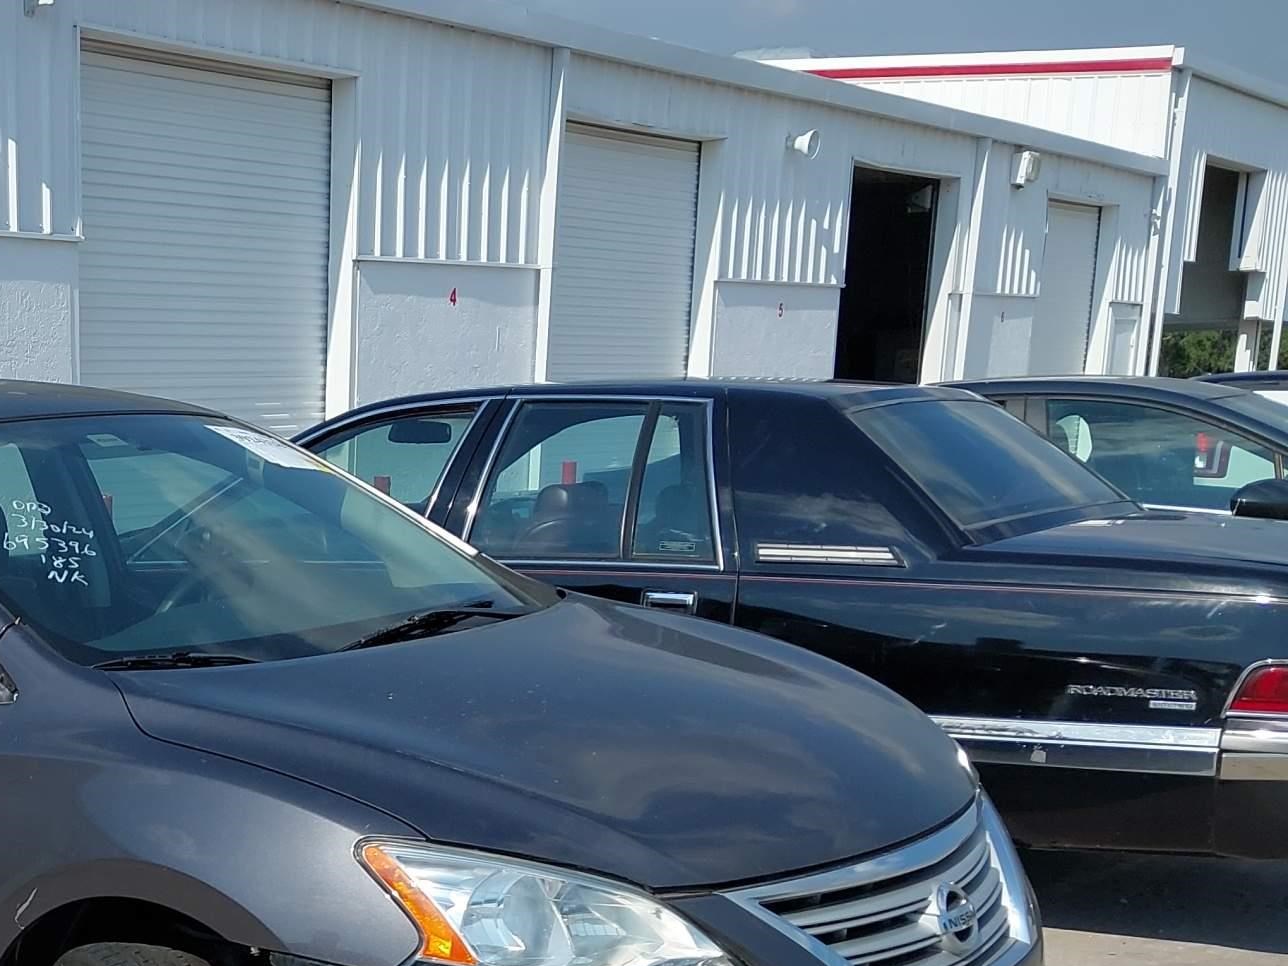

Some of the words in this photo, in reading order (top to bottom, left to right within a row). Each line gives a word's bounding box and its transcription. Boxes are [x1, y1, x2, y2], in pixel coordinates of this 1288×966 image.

[449, 287, 457, 307] 4
[40, 553, 81, 569] 185
[1067, 684, 1198, 701] ROADMASTER
